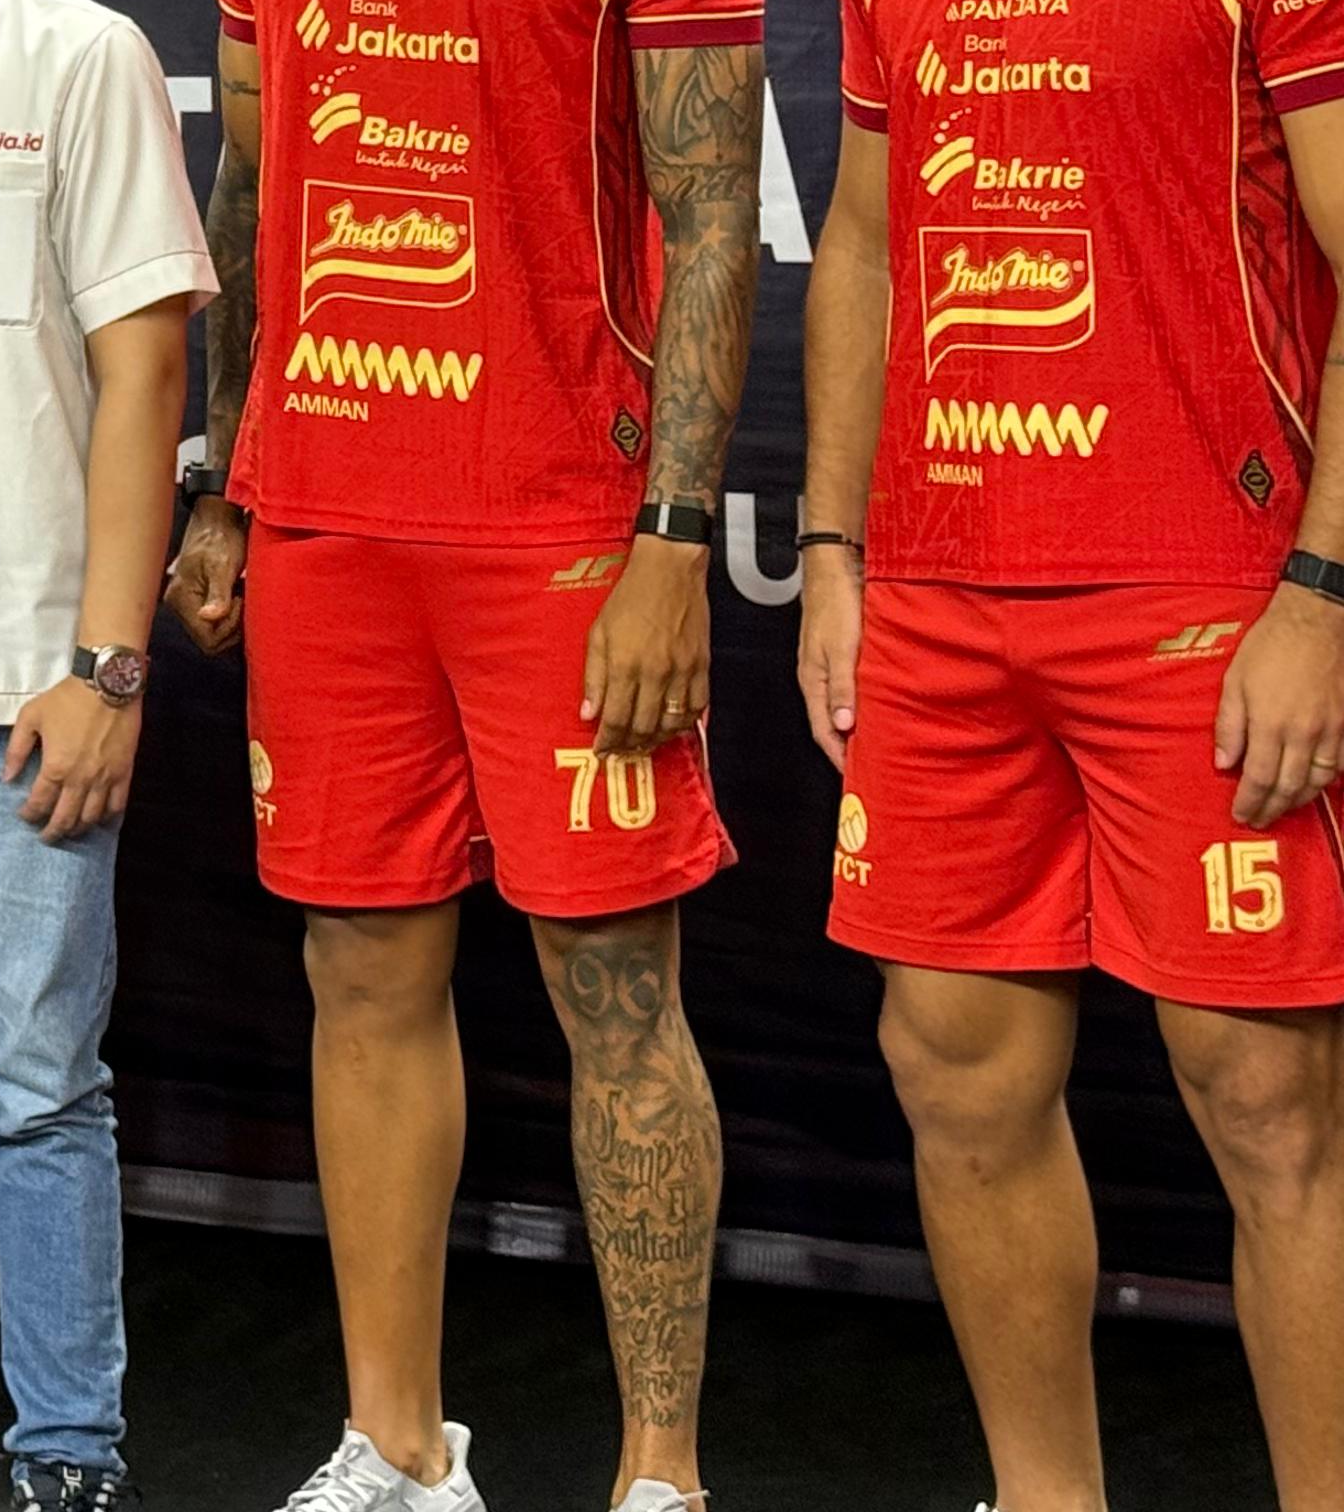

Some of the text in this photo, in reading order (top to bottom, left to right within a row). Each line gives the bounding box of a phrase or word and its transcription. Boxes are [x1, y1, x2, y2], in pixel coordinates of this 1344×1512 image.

[335, 21, 480, 64] Jakarta
[359, 114, 471, 156] Bakrie
[283, 392, 369, 422] AMMAN
[554, 748, 656, 834] 70
[1200, 839, 1286, 935] 15
